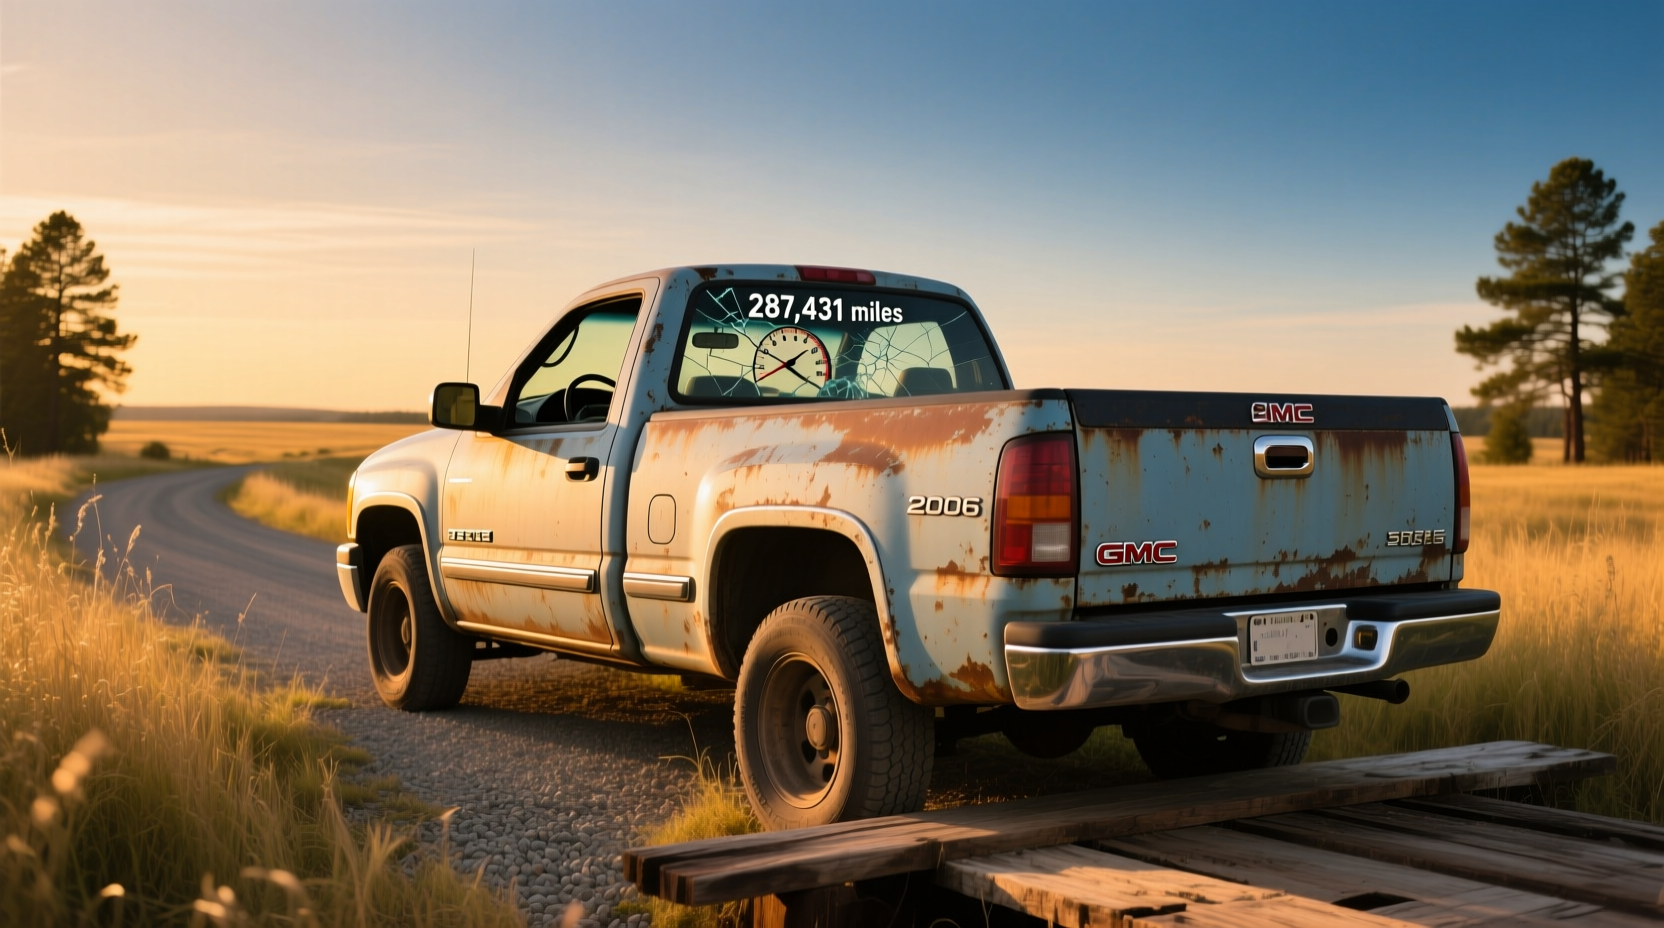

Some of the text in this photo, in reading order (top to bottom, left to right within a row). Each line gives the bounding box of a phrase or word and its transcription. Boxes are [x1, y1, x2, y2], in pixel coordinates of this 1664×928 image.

[748, 293, 904, 324] 287,431 miles
[907, 496, 981, 517] 2006
[1096, 540, 1178, 566] GMC
